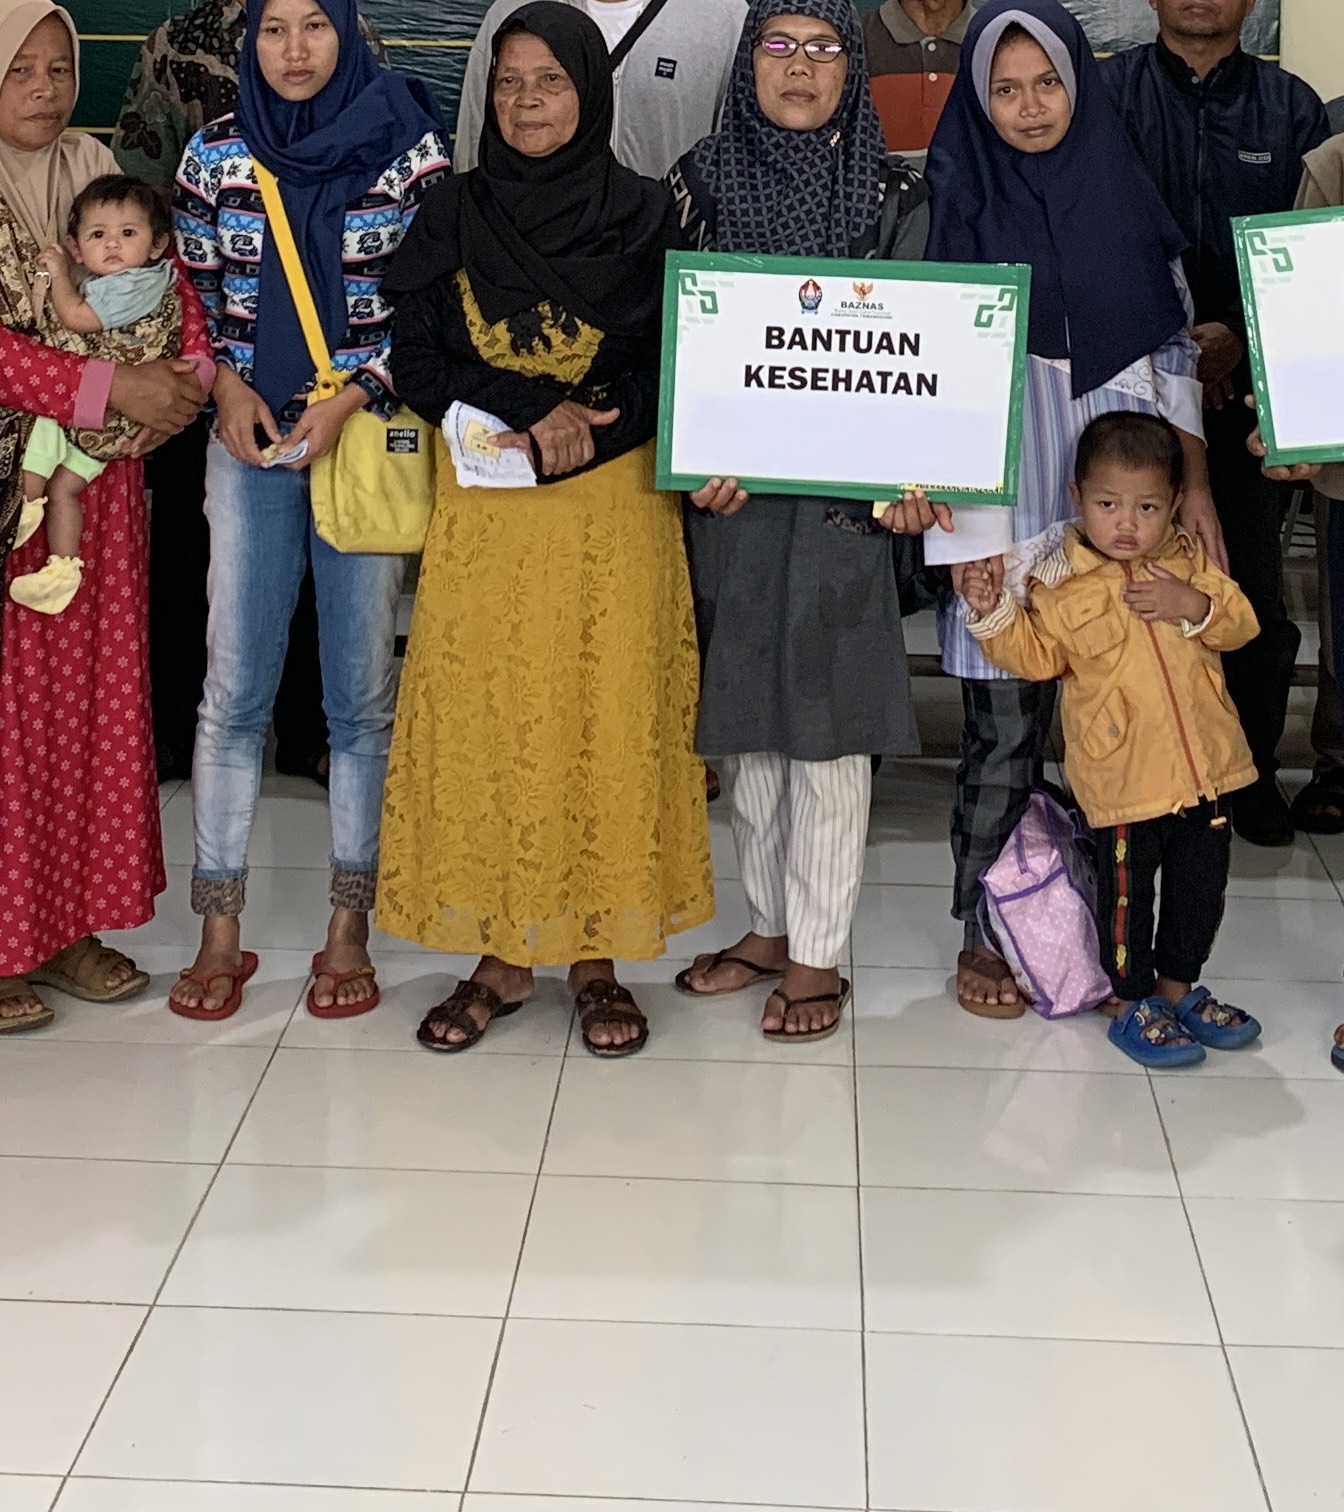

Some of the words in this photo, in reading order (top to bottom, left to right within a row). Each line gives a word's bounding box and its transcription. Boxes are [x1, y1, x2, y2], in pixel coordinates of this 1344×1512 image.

[840, 300, 884, 311] BAZNAS
[765, 326, 921, 357] BANTUAN
[744, 364, 938, 397] KESEHATAN
